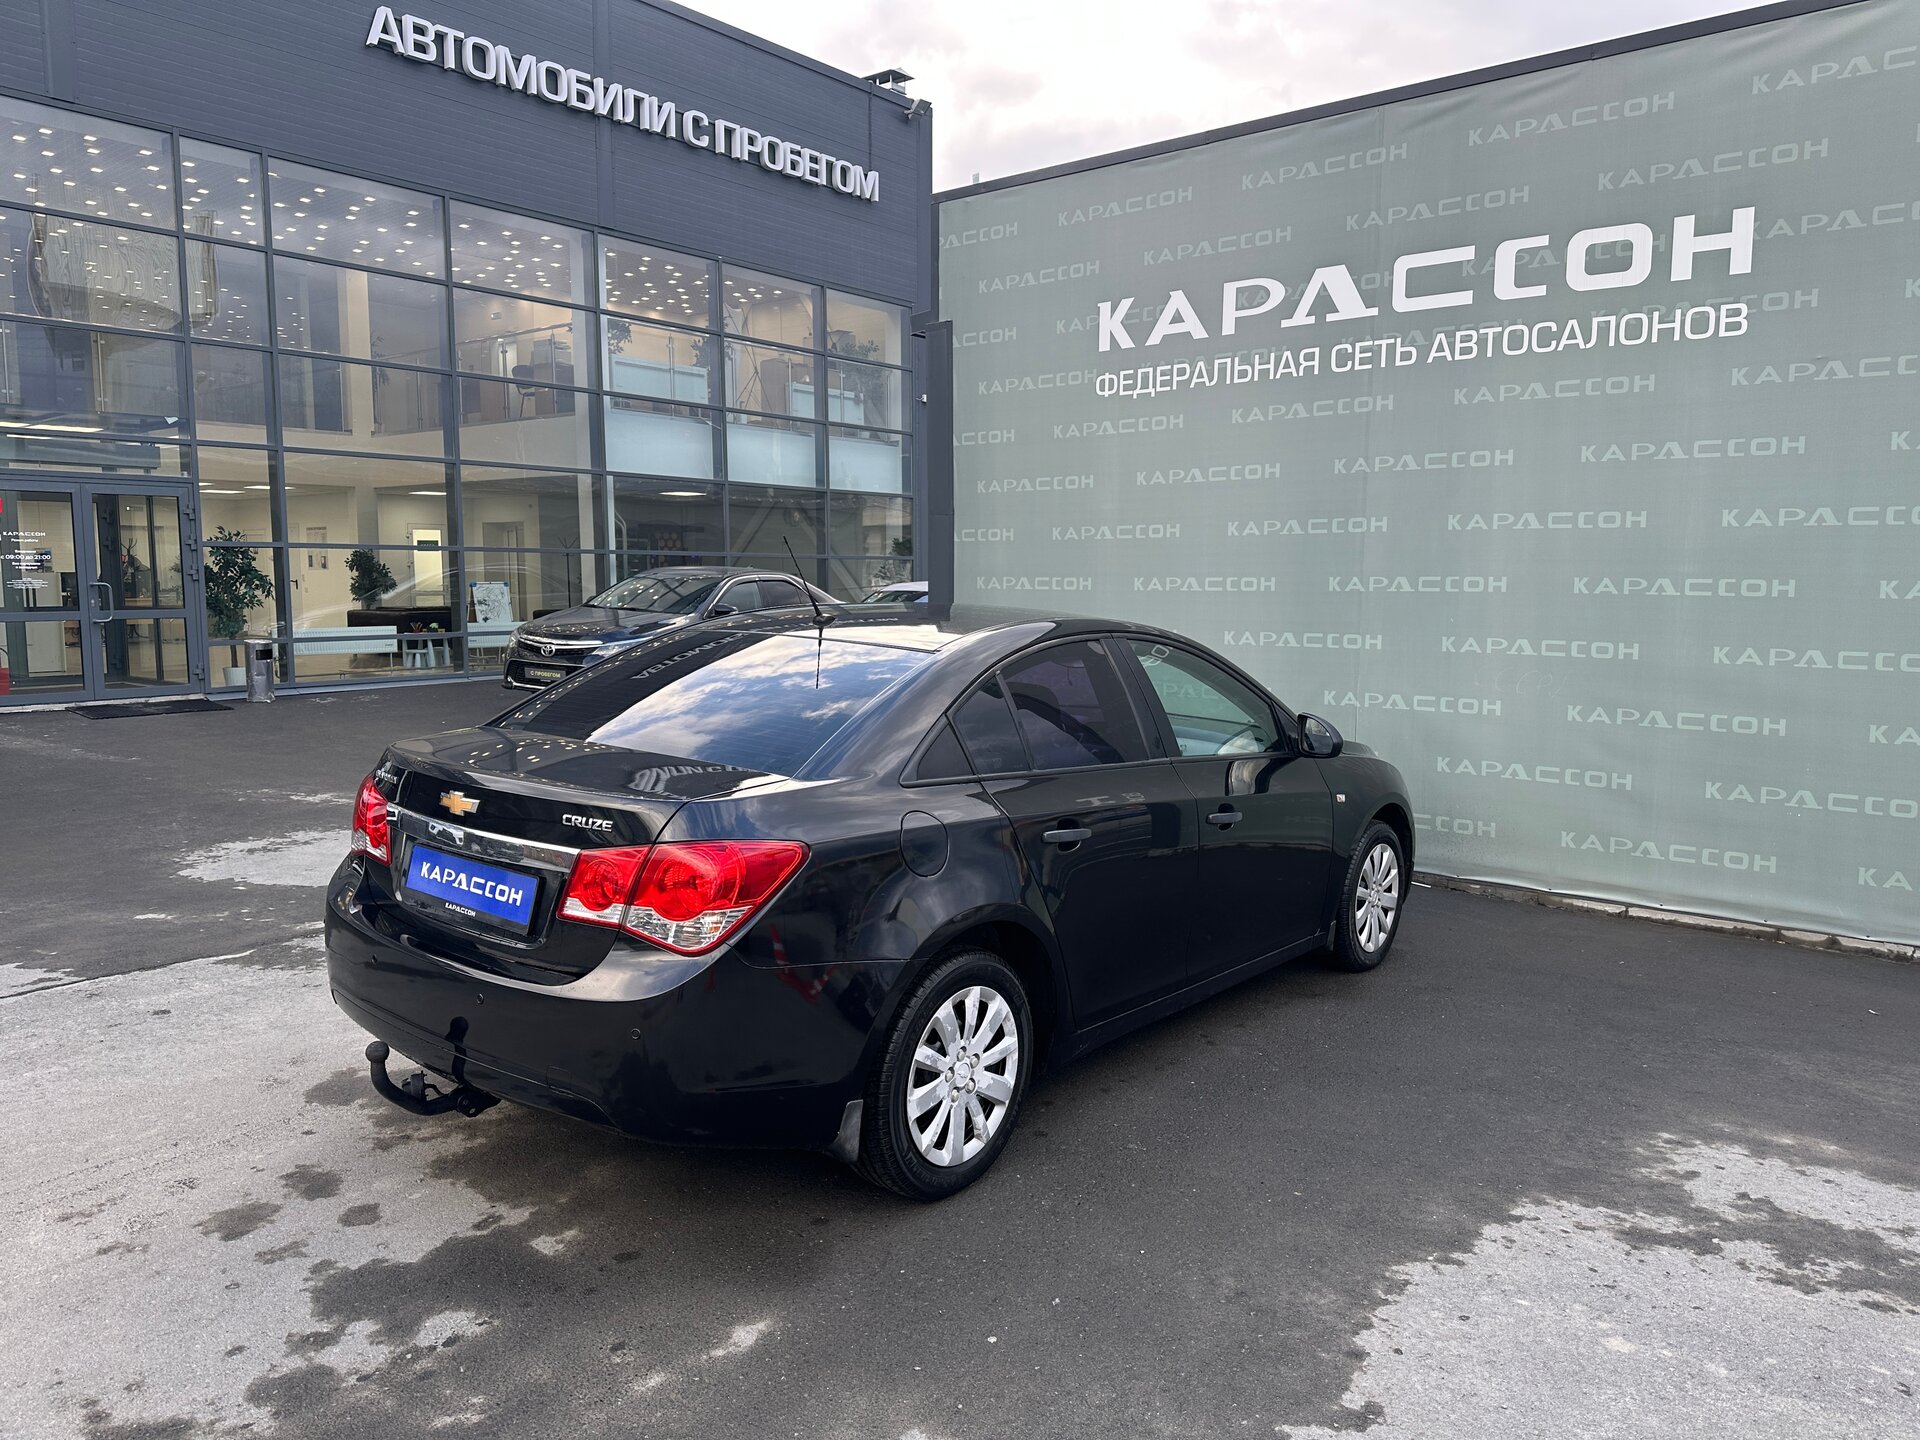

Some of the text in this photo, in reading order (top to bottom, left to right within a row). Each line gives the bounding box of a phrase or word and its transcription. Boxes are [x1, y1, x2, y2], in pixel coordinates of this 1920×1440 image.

[1751, 46, 1918, 94] КАРАС
[366, 5, 879, 202] АВТОМОБИЛИ С ПРОБЕГОМ
[1468, 91, 1675, 146] КАРАССОН
[1241, 143, 1408, 190] КАРАССОН
[1597, 138, 1829, 190] КАРАССОН
[1057, 186, 1193, 227] КАРАССОН
[1346, 186, 1530, 231] КАРАССОН
[939, 222, 1018, 248] АССОН
[1143, 225, 1292, 265] КАРАССОН
[978, 260, 1100, 293] КАРАССОН
[1097, 206, 1756, 352] КАРАССОН
[1095, 302, 1749, 399] ФЕДЕРАЛЬНАЯ СЕТЬ АВТОСАЛОНОВ
[978, 369, 1098, 397] КАРАССОН
[1731, 354, 1920, 386] КАРАСС
[1454, 374, 1656, 405] КАРАССОН
[1231, 395, 1394, 424] КАРАССОН
[1053, 414, 1184, 439] КАРАССОН
[1334, 449, 1514, 474] КАРАССОН
[1580, 435, 1806, 462] КАРАССОН
[976, 474, 1094, 493] КАРАССОН
[1136, 462, 1281, 486] КАРАССОН
[1227, 516, 1388, 536] КАРАССОН
[1447, 510, 1647, 530] КАРАССОН
[1721, 506, 1920, 527] КАРАСС
[1052, 523, 1180, 540] КАРАССОН
[976, 576, 1092, 591] КАРАССОН
[1133, 576, 1276, 592] КАРАССОН
[1328, 576, 1507, 592] КАРАССОН
[1573, 576, 1796, 597] КАРАССОН
[1223, 630, 1383, 650] КАРАССОН
[1441, 636, 1639, 660] КАРАССОН
[1712, 646, 1920, 672] КАРАССО
[1324, 690, 1501, 716] КАРАССОН
[1566, 704, 1786, 737] КАРАССОН
[1436, 756, 1633, 791] КАРАССОН
[1704, 780, 1920, 819] КАРАССО
[562, 813, 614, 833] CRUZE
[1413, 812, 1496, 838] ССОН
[1560, 830, 1777, 874] КАРАССОН
[420, 861, 523, 907] КАРАССОН
[445, 902, 476, 917] КАРАССОН
